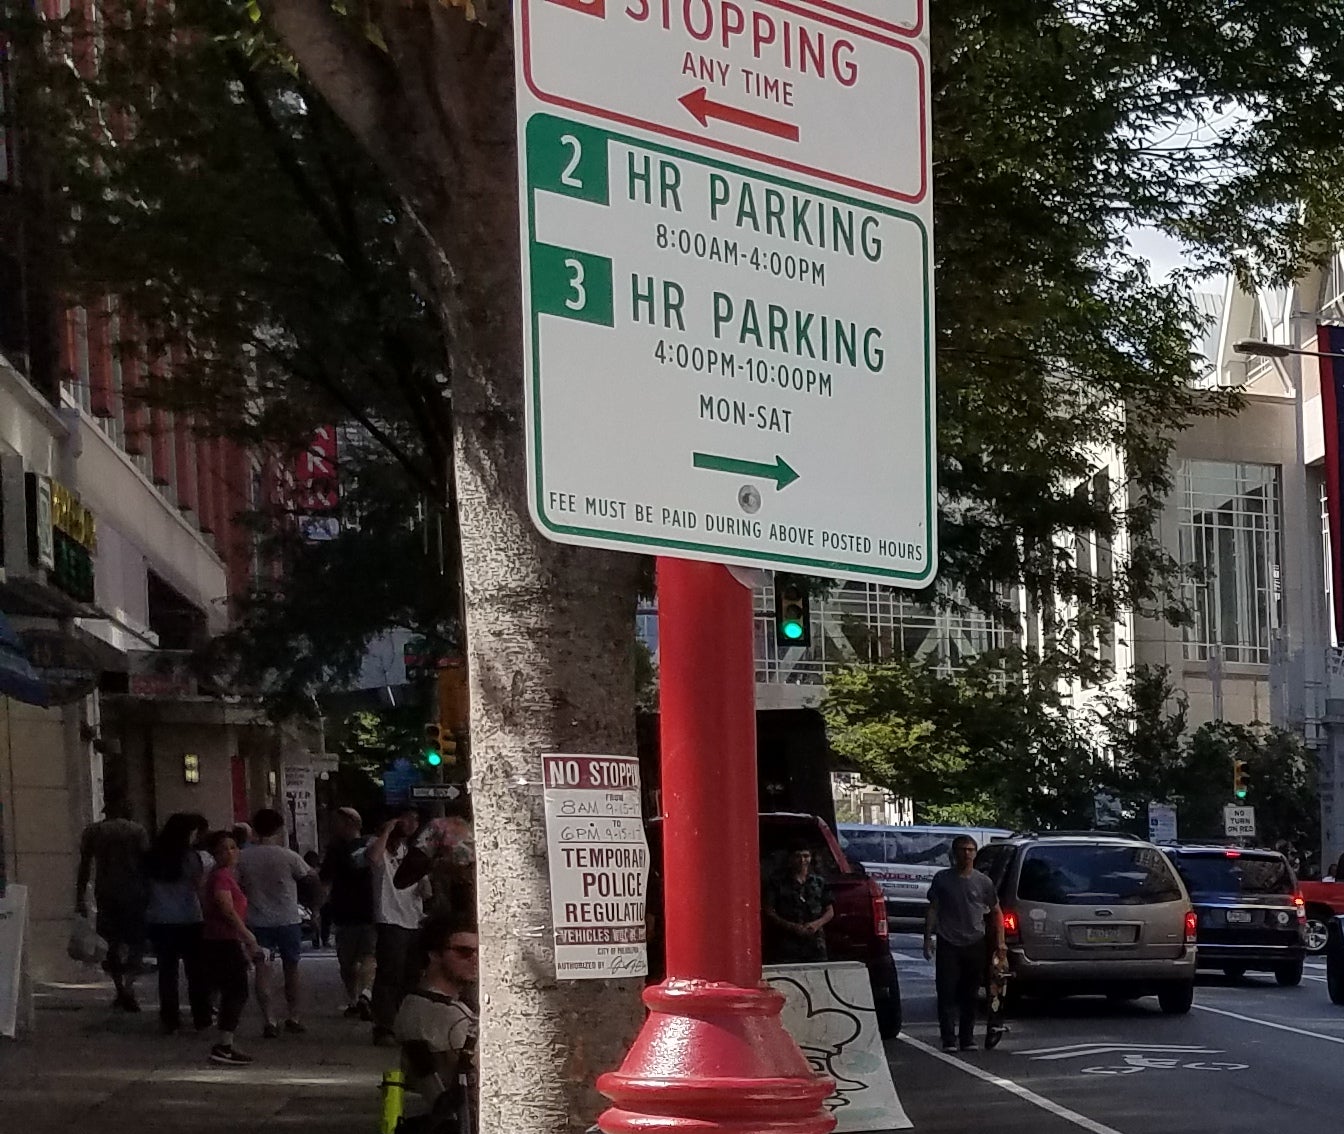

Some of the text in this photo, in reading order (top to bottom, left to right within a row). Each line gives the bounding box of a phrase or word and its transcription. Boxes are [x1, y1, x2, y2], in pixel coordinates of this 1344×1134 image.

[682, 51, 794, 106] ANY TIME
[560, 134, 882, 263] 2 HR PARKING
[655, 223, 826, 287] 8:00AM-4:00PM
[564, 258, 885, 373] 3 HR PARKING
[654, 339, 832, 397] 4:00PM-10:00PM
[699, 394, 792, 434] MON-SAT
[549, 491, 922, 562] FEE MUST BE PAID DURING ABOVE POSTED HOURS
[549, 761, 579, 786] NO
[561, 848, 646, 868] TEMPORAR
[583, 872, 642, 897] POLICE
[560, 929, 610, 942] VEHICLES
[565, 903, 644, 923] REGULATIO
